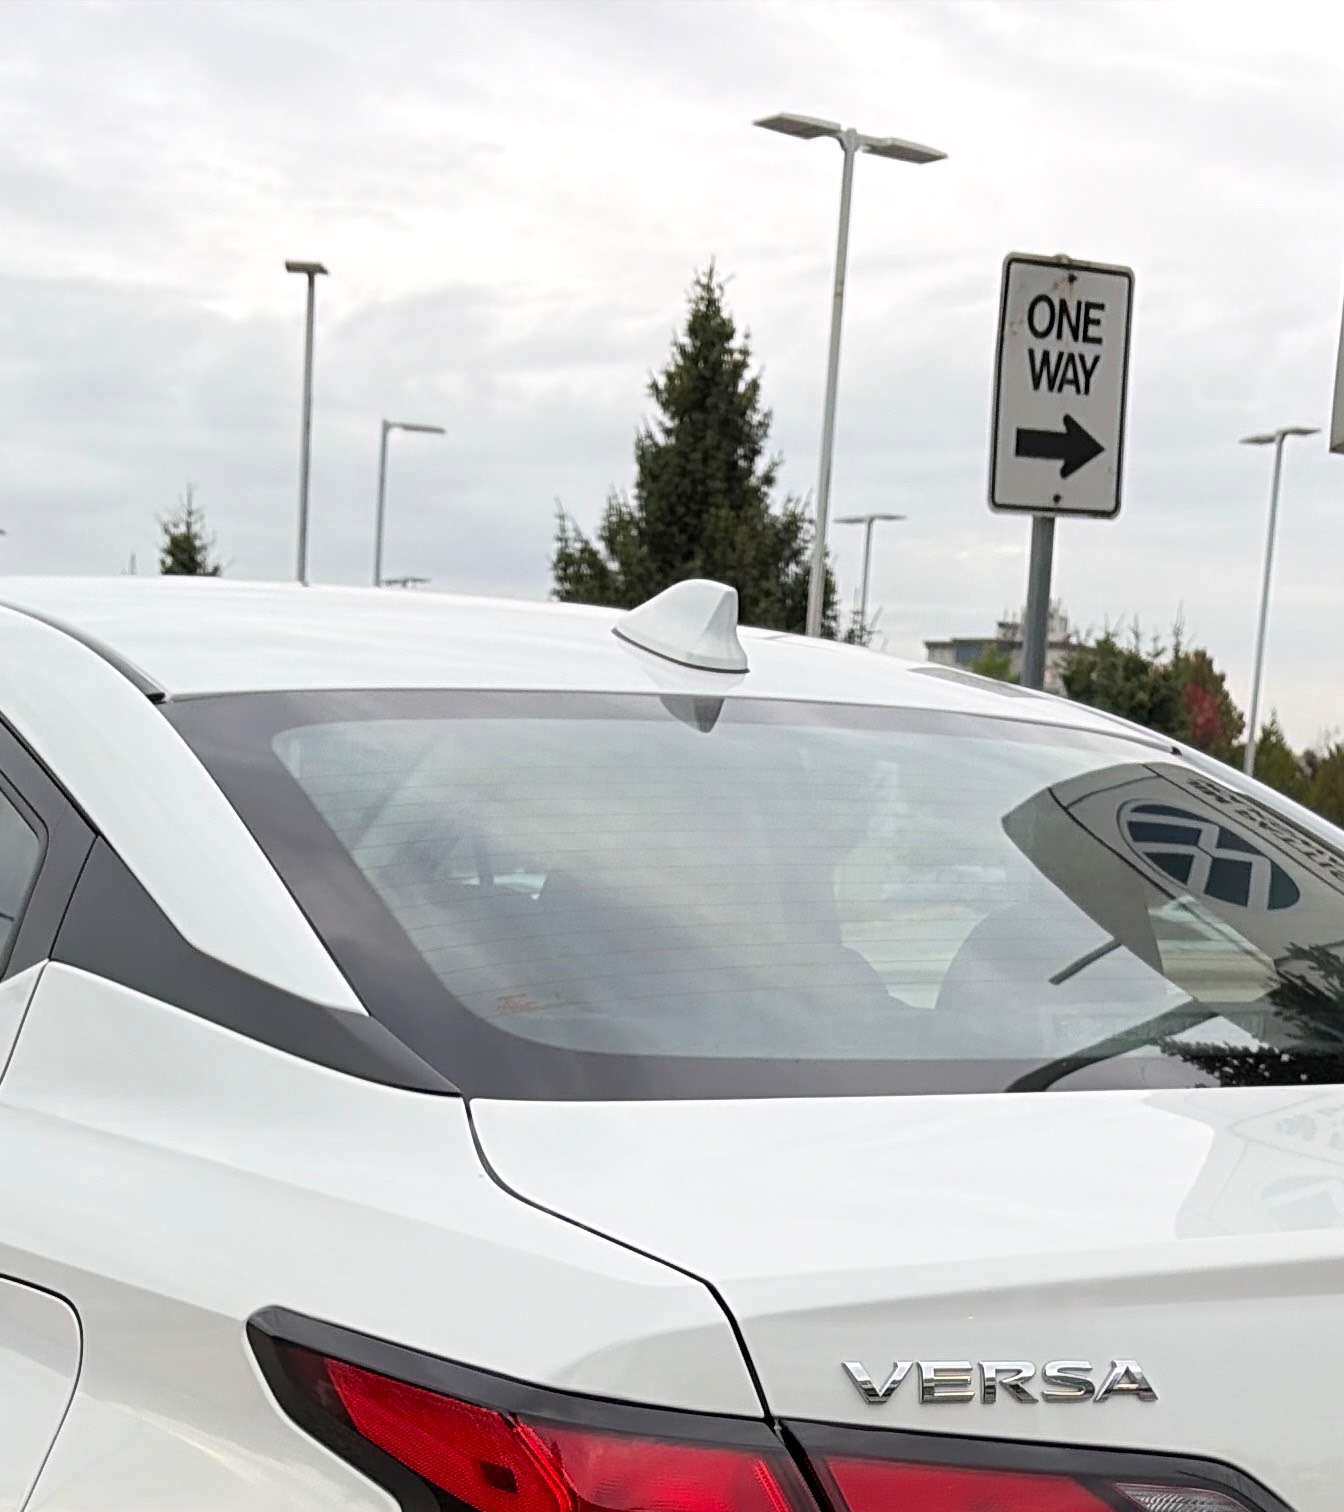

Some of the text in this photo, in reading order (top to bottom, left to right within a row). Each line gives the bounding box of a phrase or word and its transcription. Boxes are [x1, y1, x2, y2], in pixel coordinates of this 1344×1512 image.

[1027, 294, 1105, 345] ONE
[1028, 348, 1101, 396] WAY
[840, 1359, 1158, 1403] VERSA
